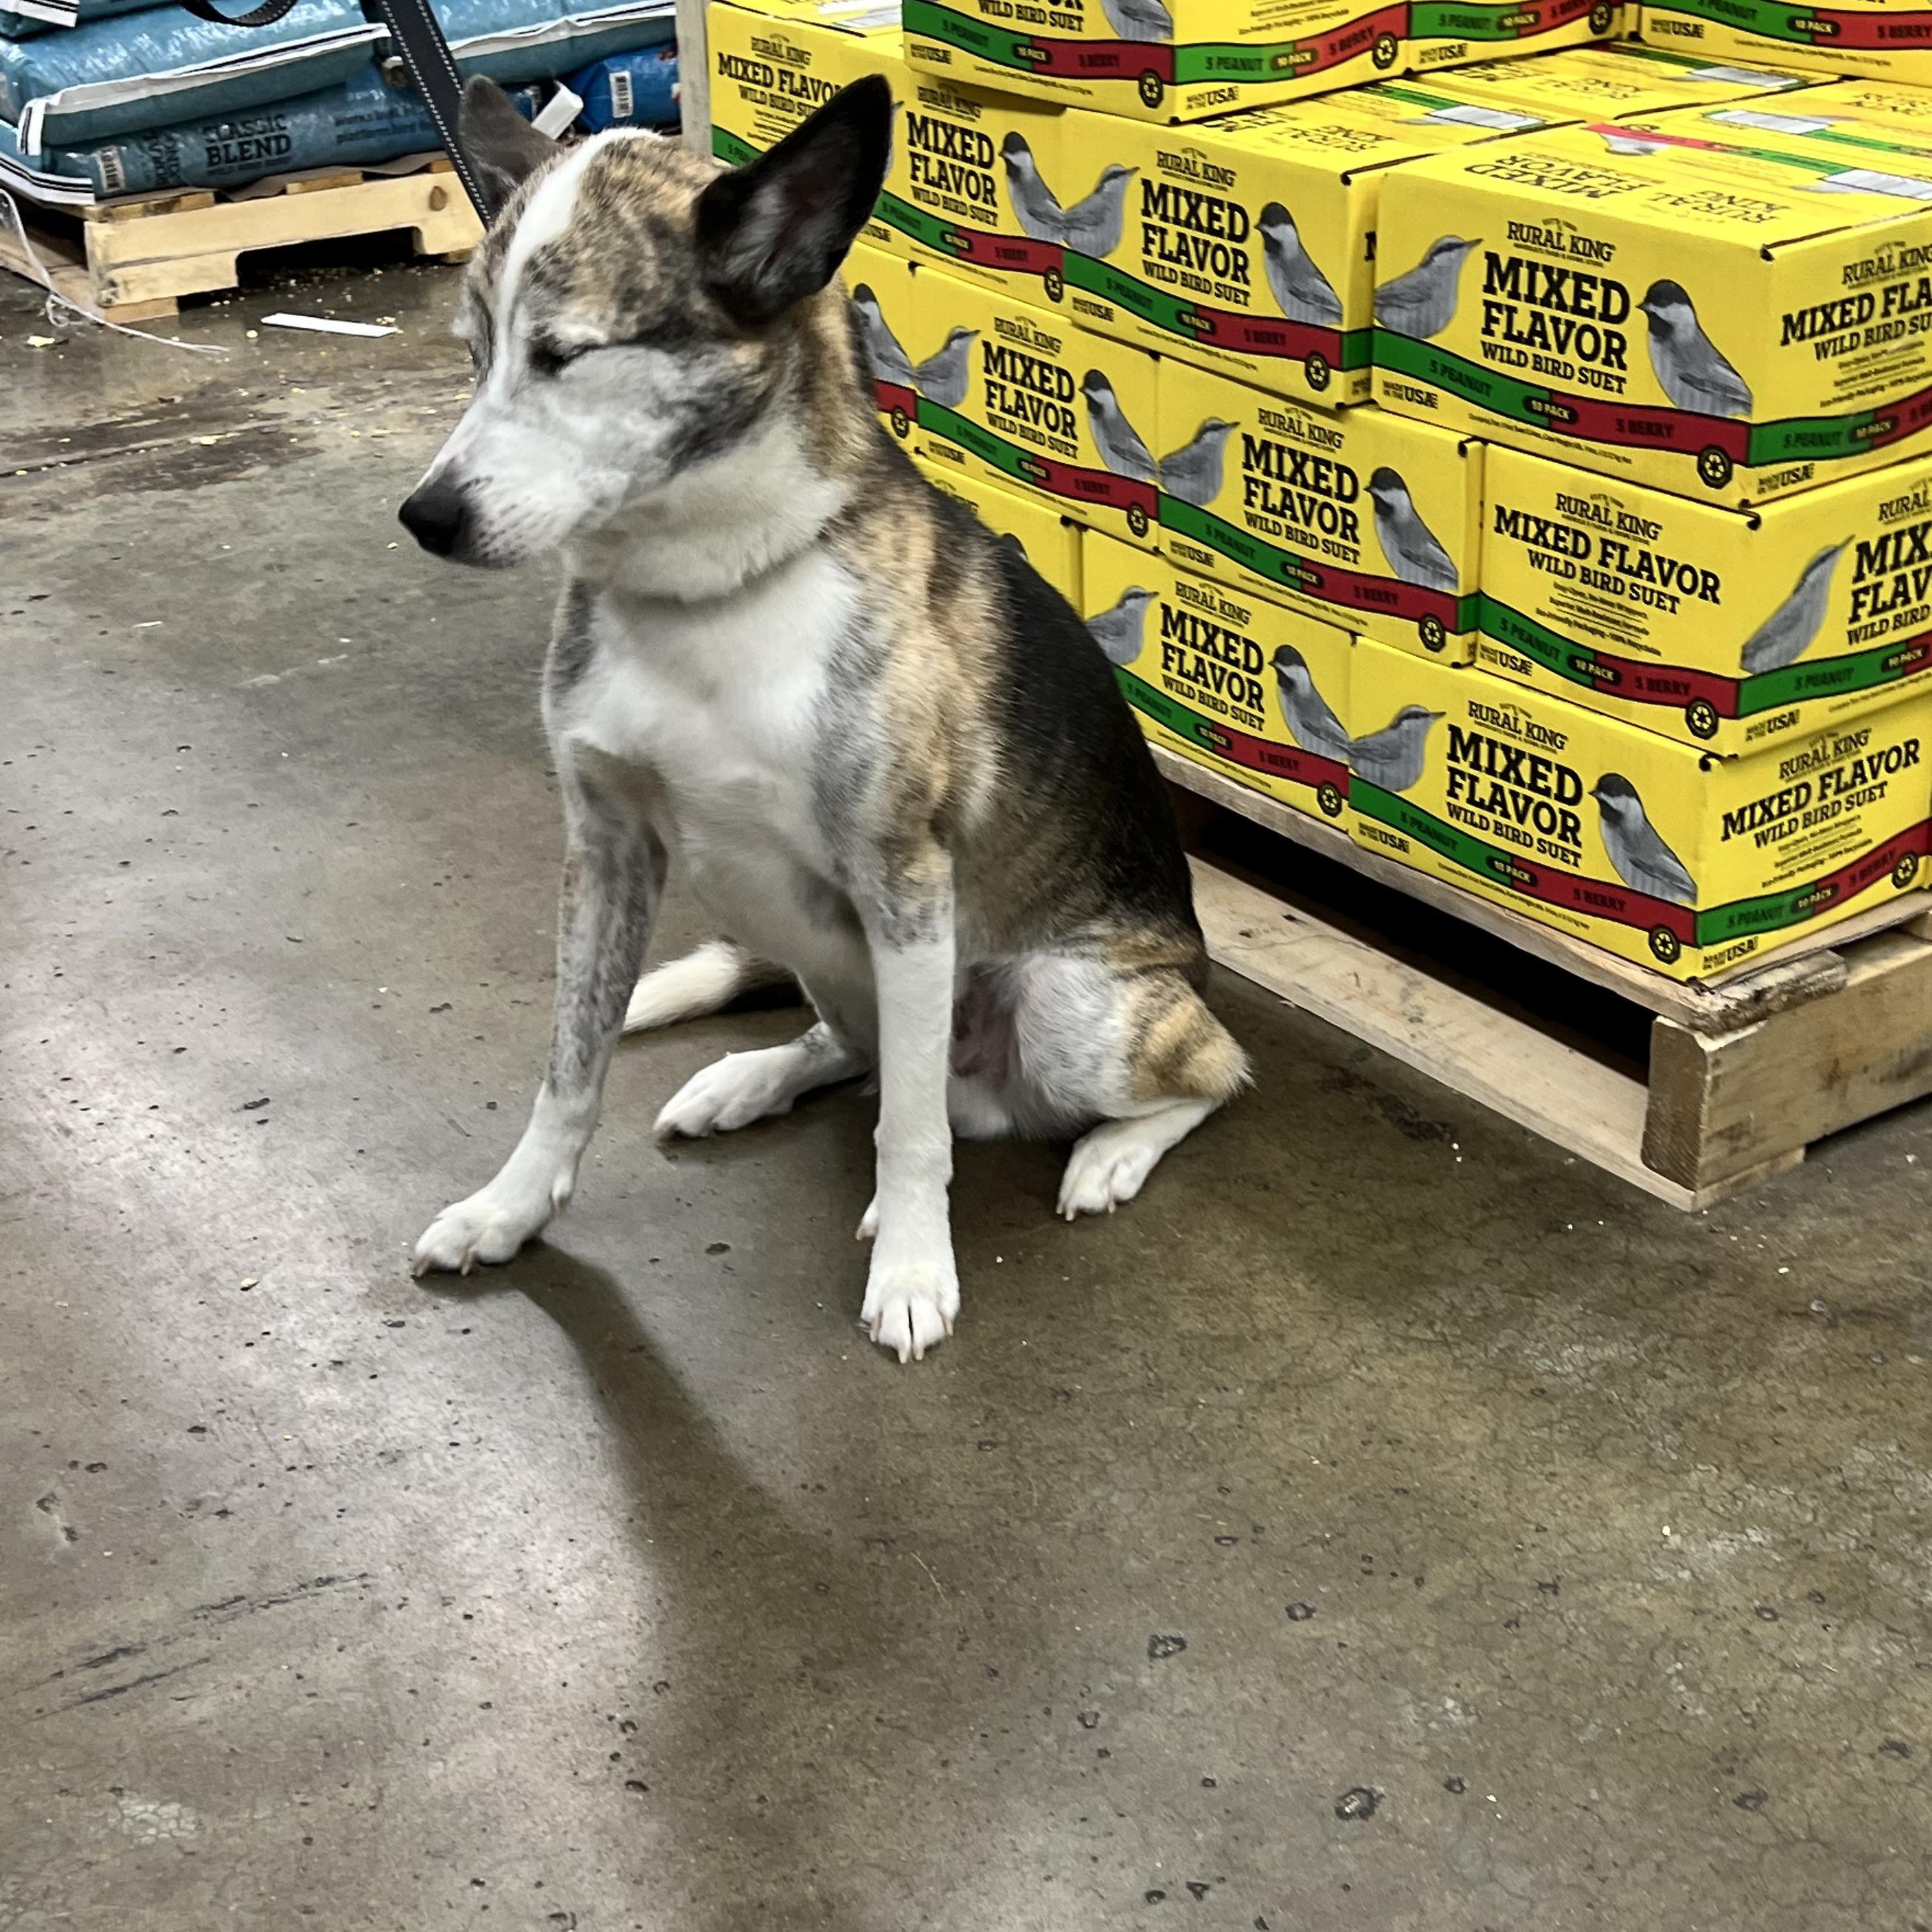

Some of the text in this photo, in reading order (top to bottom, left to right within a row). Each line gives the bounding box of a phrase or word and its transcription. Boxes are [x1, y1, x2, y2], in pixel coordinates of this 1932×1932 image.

[979, 0, 1013, 17] WILD
[1050, 13, 1084, 32] SUET
[1673, 21, 1705, 38] USA
[717, 52, 842, 103] MIXED FLAVO
[1217, 56, 1263, 72] PEANUT
[1207, 86, 1239, 104] USA
[206, 134, 292, 167] BLEND
[906, 111, 995, 169] MIXED
[908, 150, 998, 208] FLAVOR
[1156, 150, 1238, 188] RURAL KING
[1464, 164, 1622, 199] MIXED
[1140, 178, 1250, 244] MIXED
[1142, 222, 1250, 286] FLAVOR
[1506, 220, 1567, 252] RURAL
[1569, 236, 1616, 264] KING
[1142, 259, 1250, 307] WILD BIRD SUET
[1482, 250, 1631, 325] MIXED
[1841, 255, 1896, 284] RURAL
[1480, 299, 1628, 371] FLAVOR
[1780, 292, 1875, 346] MIXED
[1814, 332, 1861, 362] WILD
[1863, 320, 1905, 348] BIRD
[981, 340, 1075, 404] MIXED
[1480, 341, 1627, 395] WILD BIRD SUET
[984, 378, 1078, 441] FLAVOR
[986, 411, 1016, 436] WILD
[1404, 385, 1439, 410] USA
[1439, 363, 1494, 399] PEANUT
[1545, 401, 1571, 421] PACK
[1628, 420, 1675, 439] BERRY
[1257, 408, 1346, 450] RURAL KING
[1241, 433, 1360, 505] MIXED
[1243, 475, 1360, 545] FLAVOR
[1555, 493, 1663, 541] RURAL KING
[1878, 489, 1931, 521] RURAL
[1243, 510, 1361, 566] WILD BIRD SUET
[1493, 504, 1722, 606] MIXED FLAVOR
[1853, 521, 1932, 584] MIX
[1214, 527, 1257, 560] PEANUT
[1363, 586, 1400, 606] BERRY
[1527, 548, 1681, 615] WILD BIRD SUET
[1175, 581, 1217, 610] RURAL
[1218, 597, 1252, 625] KING
[1848, 564, 1932, 625] FLAV
[1160, 602, 1264, 677] MIXED
[1846, 604, 1931, 646] WILD BIRD
[1162, 640, 1264, 714] FLAVOR
[1498, 651, 1533, 677] USA
[1510, 622, 1562, 661] PEANUT
[1587, 661, 1616, 682] PACK
[1647, 677, 1691, 696] BERRY
[1805, 668, 1855, 689] PEANUT
[1162, 673, 1264, 732] WILD BIRD SUET
[1467, 700, 1568, 750] RURAL KING
[1767, 709, 1800, 733] USA
[1447, 723, 1583, 806] MIXED
[1779, 728, 1872, 779] RURAL KING
[1446, 765, 1583, 848] FLAVOR
[1721, 738, 1920, 842] MIXED FLAVOR
[1754, 781, 1888, 849] WILD BIRD SUET
[1446, 801, 1583, 868] WILD BIRD SUET
[1408, 815, 1457, 852] PEANUT
[1583, 891, 1626, 914] BERRY
[1737, 904, 1786, 927] PEANUT
[1726, 936, 1758, 962] USA
